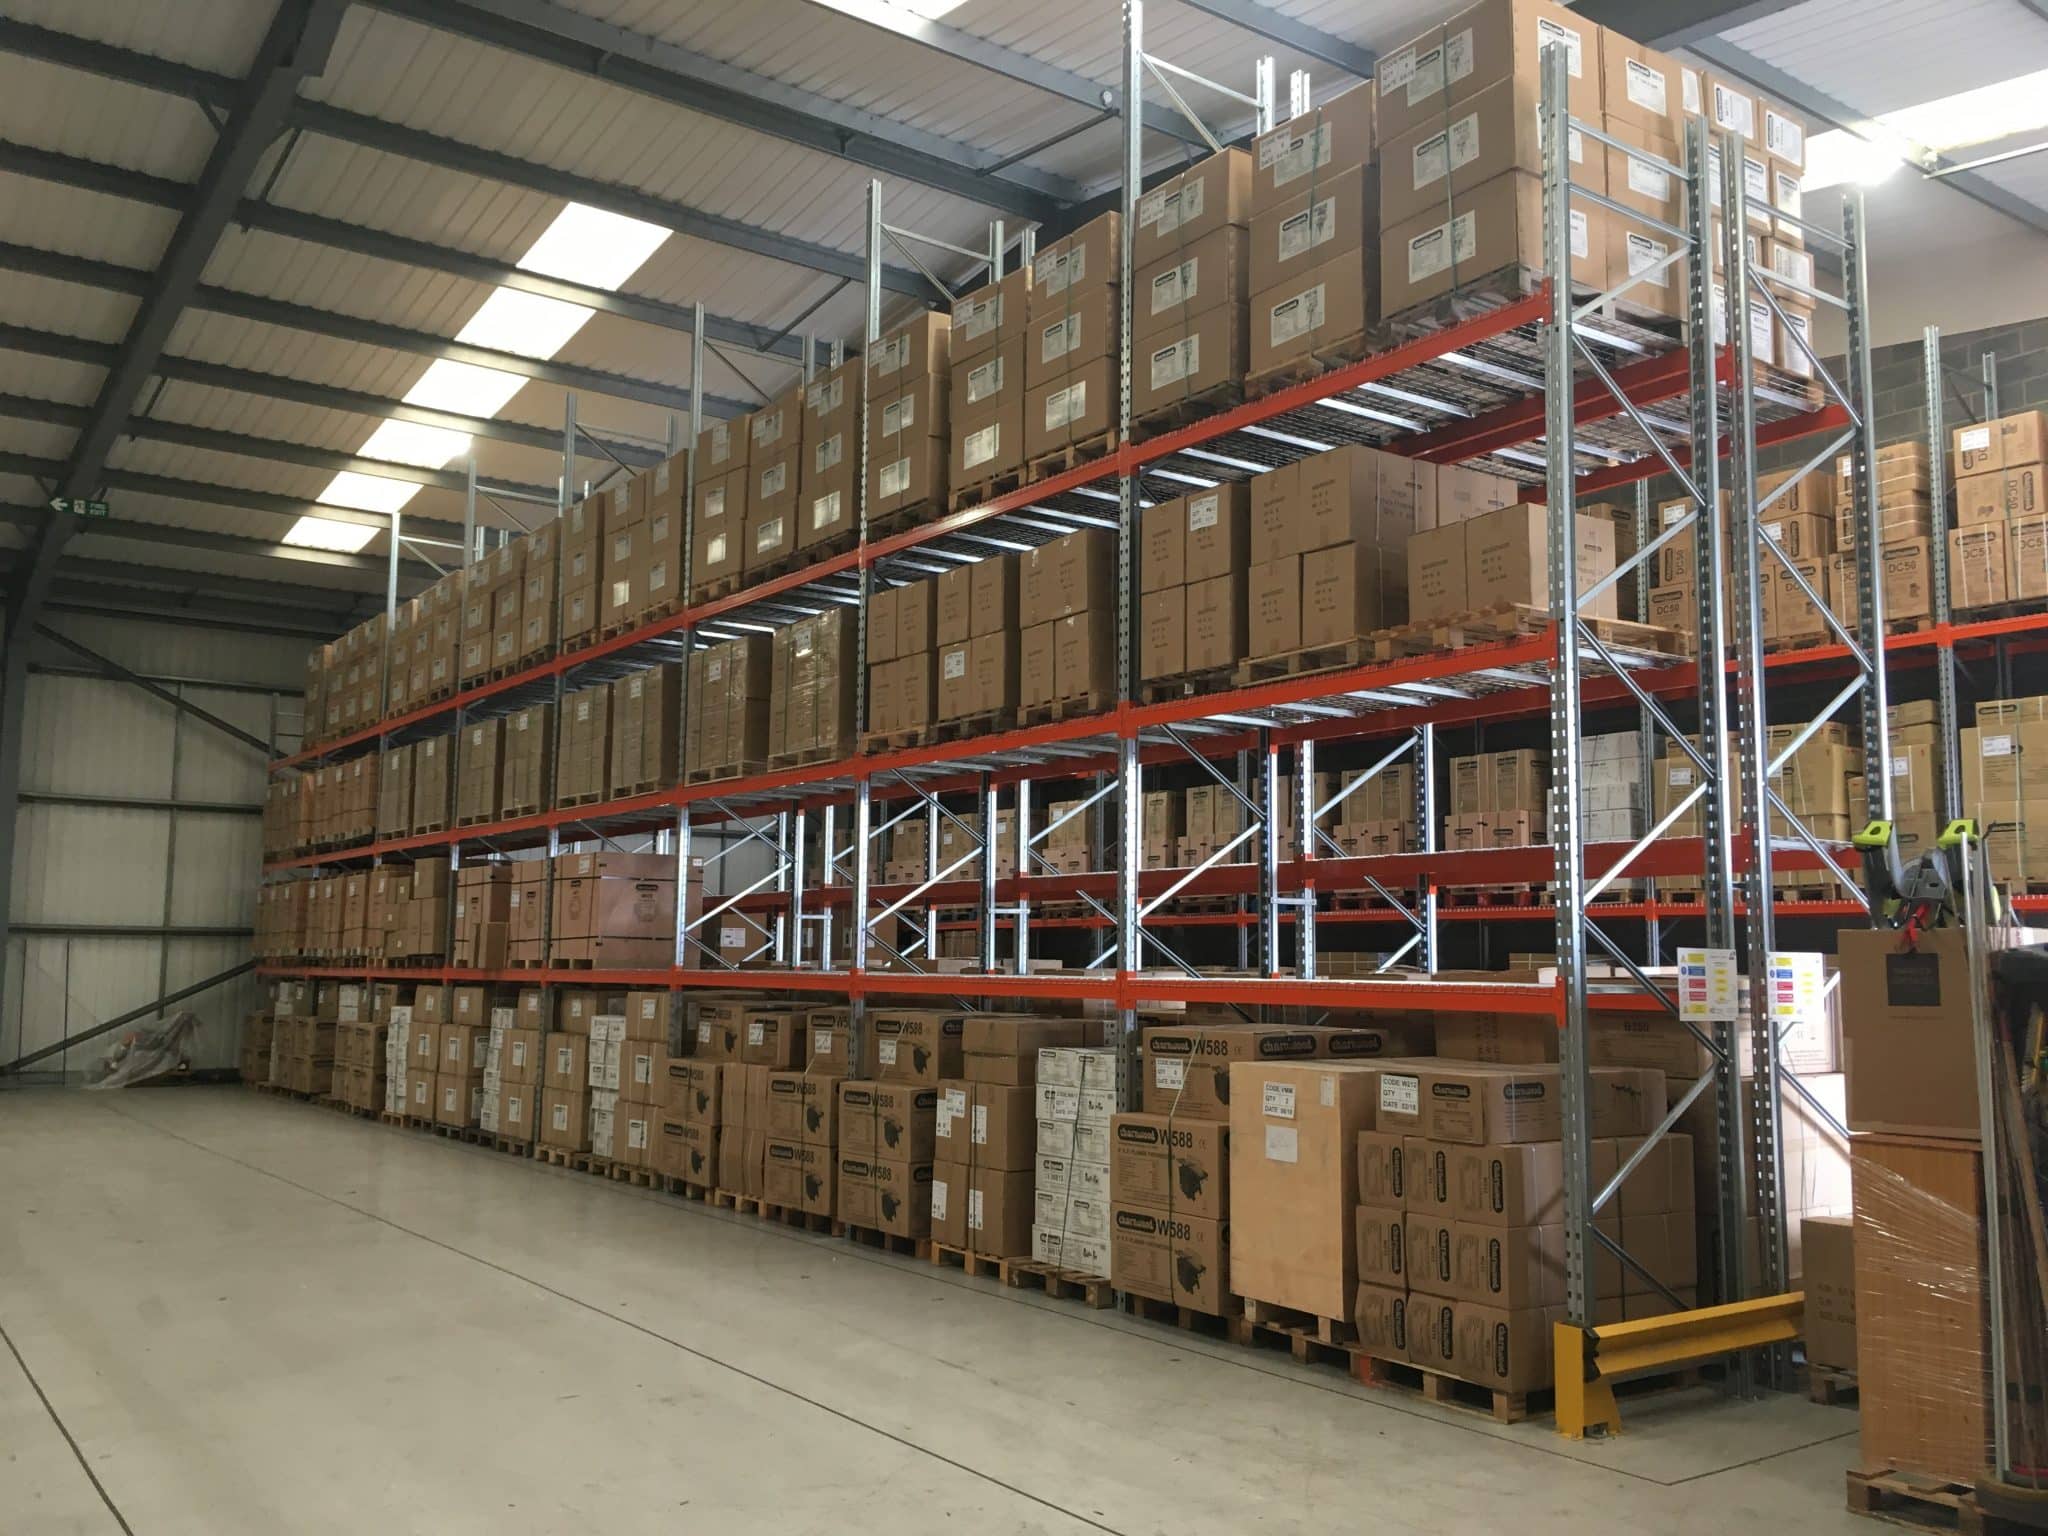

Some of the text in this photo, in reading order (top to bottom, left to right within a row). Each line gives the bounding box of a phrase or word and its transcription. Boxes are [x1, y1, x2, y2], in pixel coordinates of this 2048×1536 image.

[1888, 560, 1917, 573] DC50
[1656, 603, 1680, 615] DC50
[1193, 1039, 1228, 1056] W588
[1383, 1078, 1400, 1087] CODE
[1383, 1100, 1398, 1108] DATE
[1159, 1129, 1193, 1148] W588
[1157, 1218, 1191, 1240] W588
